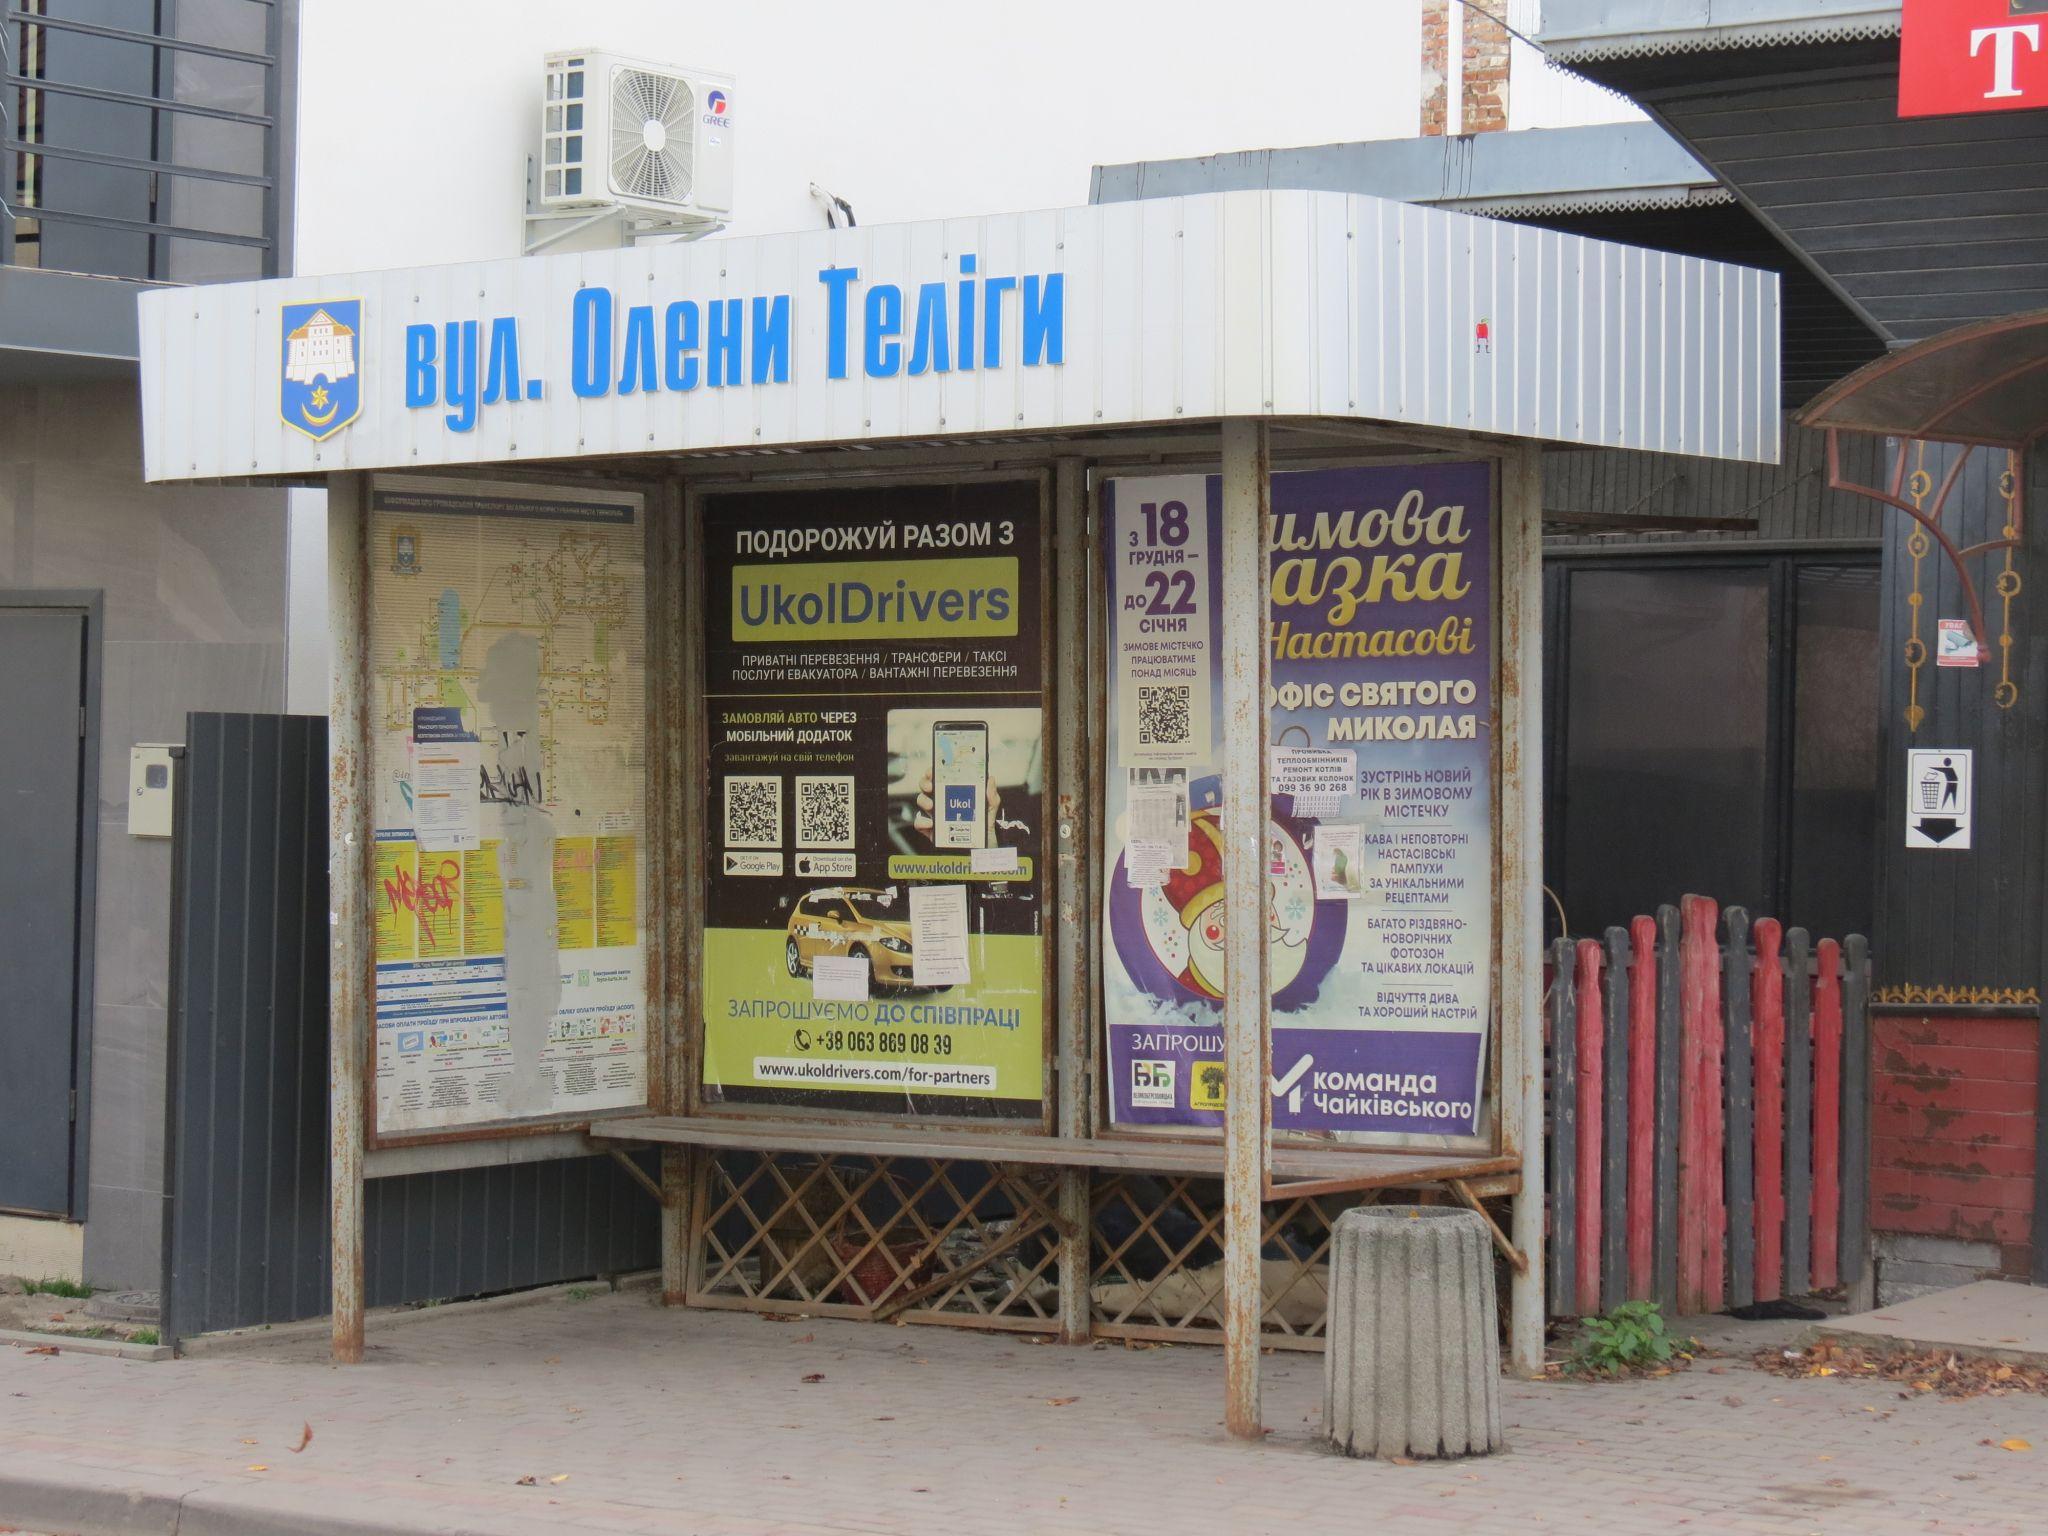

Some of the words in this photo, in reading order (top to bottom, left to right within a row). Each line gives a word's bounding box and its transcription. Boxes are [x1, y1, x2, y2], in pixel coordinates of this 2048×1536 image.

[702, 114, 731, 128] GREE
[406, 316, 543, 432] вул.
[572, 287, 792, 398] Олени
[819, 253, 1065, 379] Теліги
[1140, 500, 1190, 547] 18
[1269, 489, 1471, 552] имова
[736, 520, 896, 558] ПОДОРОЖУЙ
[903, 522, 991, 549] РАЗОМ
[1129, 550, 1184, 566] ГРУДНЯ
[1124, 595, 1147, 610] ДО
[1145, 569, 1197, 615] 22
[1270, 552, 1472, 626] азка
[740, 579, 1010, 627] UkolDrivers
[1139, 618, 1187, 633] СІЧНЯ
[1123, 642, 1159, 652] ЗИМОВЕ
[1160, 640, 1204, 651] МІСТЕЧКО
[742, 654, 797, 666] ПРИВАТНІ
[800, 653, 880, 666] ПЕРЕВЕЗЕННЯ
[891, 652, 961, 664] ТРАНСФЕРИ
[973, 651, 1007, 662] ТАКСІ
[1131, 654, 1196, 666] ПРАЦЮВАТИМЕ
[732, 669, 785, 681] ПОСЛУГИ
[787, 668, 858, 680] ЕВАКУАТОРА
[869, 667, 930, 679] ВАНТАЖНІ
[933, 665, 1018, 678] ПЕРЕВЕЗЕННЯ
[1131, 669, 1162, 679] ПОНАД
[1163, 668, 1197, 678] МІСЯЦЬ
[1339, 679, 1477, 707] СВЯТОГО
[722, 710, 785, 724] ЗАМОВЛЯЙ
[787, 712, 818, 724] АВТО
[820, 711, 857, 724] ЧЕРЕЗ
[1327, 714, 1477, 741] МИКОЛАЯ
[726, 728, 794, 742] МОБІЛЬНИЙ
[796, 730, 853, 744] ДОДАТОК
[724, 751, 779, 764] завантажуй
[780, 753, 792, 762] на
[793, 751, 813, 762] свій
[815, 751, 854, 764] телефон
[1360, 770, 1422, 783] ЗУСТРІНЬ
[1424, 767, 1471, 782] НОВИЙ
[1278, 783, 1297, 792] 099
[1299, 783, 1311, 792] 36
[1314, 783, 1326, 792] 90
[1329, 783, 1347, 792] 268
[1360, 788, 1380, 800] РІК
[1383, 788, 1391, 800] В
[1394, 787, 1473, 800] ЗИМОВОМУ
[949, 798, 971, 809] Ukol
[1384, 804, 1449, 818] МІСТЕЧКУ
[1364, 834, 1393, 845] КАВА
[1401, 834, 1469, 845] НЕПОВТОРНІ
[1378, 848, 1456, 859] НАСТАСІВСЬКІ
[740, 862, 765, 872] Google
[766, 862, 781, 872] Play
[813, 862, 831, 873] App
[832, 863, 853, 872] Store
[1390, 863, 1443, 874] ПАМПУХИ
[1369, 878, 1383, 889] ЗА
[1384, 878, 1464, 889] УНІКАЛЬНИМИ
[1385, 892, 1449, 904] РЕЦЕПТАМИ
[1367, 918, 1407, 929] БАГАТО
[1409, 918, 1467, 930] РІЗДВЯНО-
[1382, 933, 1453, 944] НОВОРІЧНИХ
[1390, 947, 1445, 959] ФОТОЗОН
[1361, 962, 1374, 973] ТА
[1376, 962, 1422, 974] ЦІКАВИХ
[1424, 961, 1474, 976] ЛОКАЦІЙ
[1377, 992, 1426, 1004] ВІДЧУТТЯ
[1429, 993, 1459, 1005] ДИВА
[728, 999, 869, 1022] ЗАПРОШУЄМО
[874, 1004, 905, 1026] ДО
[910, 1005, 1020, 1031] СПІВПРАЦІ
[1358, 1006, 1371, 1017] ТА
[1373, 1005, 1428, 1018] ХОРОШИЙ
[1431, 1005, 1478, 1019] НАСТРІЙ
[816, 1030, 844, 1051] +38
[847, 1031, 875, 1052] 063
[879, 1032, 906, 1053] 869
[910, 1033, 929, 1054] 08
[933, 1034, 952, 1055] 39
[1131, 1033, 1225, 1053] ЗАПРОШУ
[759, 1063, 991, 1085] www.ukoldrivers.com/for-partners
[1313, 1071, 1437, 1097] команда
[1313, 1093, 1472, 1120] Чайківського
